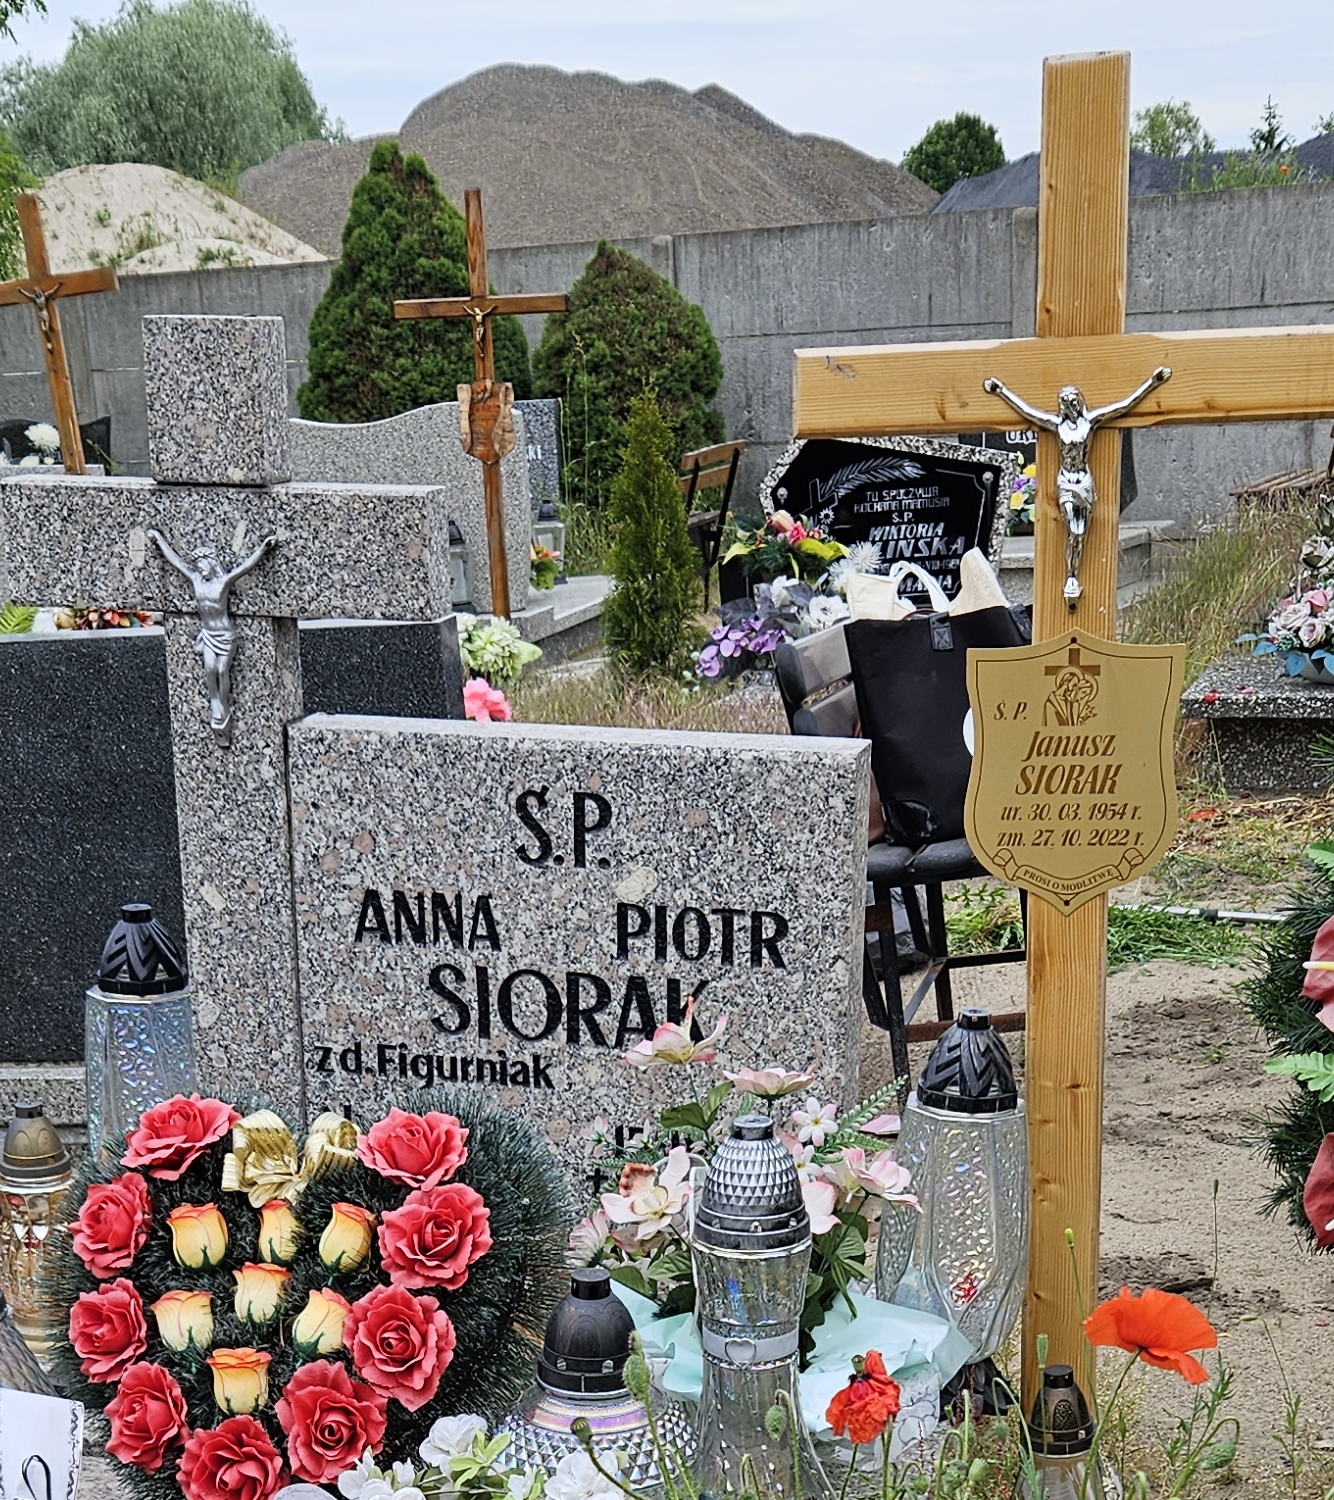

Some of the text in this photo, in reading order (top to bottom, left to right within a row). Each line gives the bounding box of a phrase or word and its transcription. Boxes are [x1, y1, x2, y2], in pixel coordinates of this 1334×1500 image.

[854, 497, 951, 514] KOCHANA MAMUSIA
[865, 491, 879, 502] TU
[868, 522, 946, 541] WIKTORIA
[993, 699, 1027, 721] Ś. P.
[1021, 731, 1116, 762] Janusz
[1015, 764, 1123, 795] SIORAK
[1000, 802, 1142, 821] ur. 30. 03. 1954 r.
[996, 829, 1145, 847] zm. 27. 10. 2022 r.
[1023, 868, 1115, 892] PROSI O MODLITWĘ
[354, 888, 789, 970] ANNA PIOTR
[428, 963, 710, 1049] SIORAK
